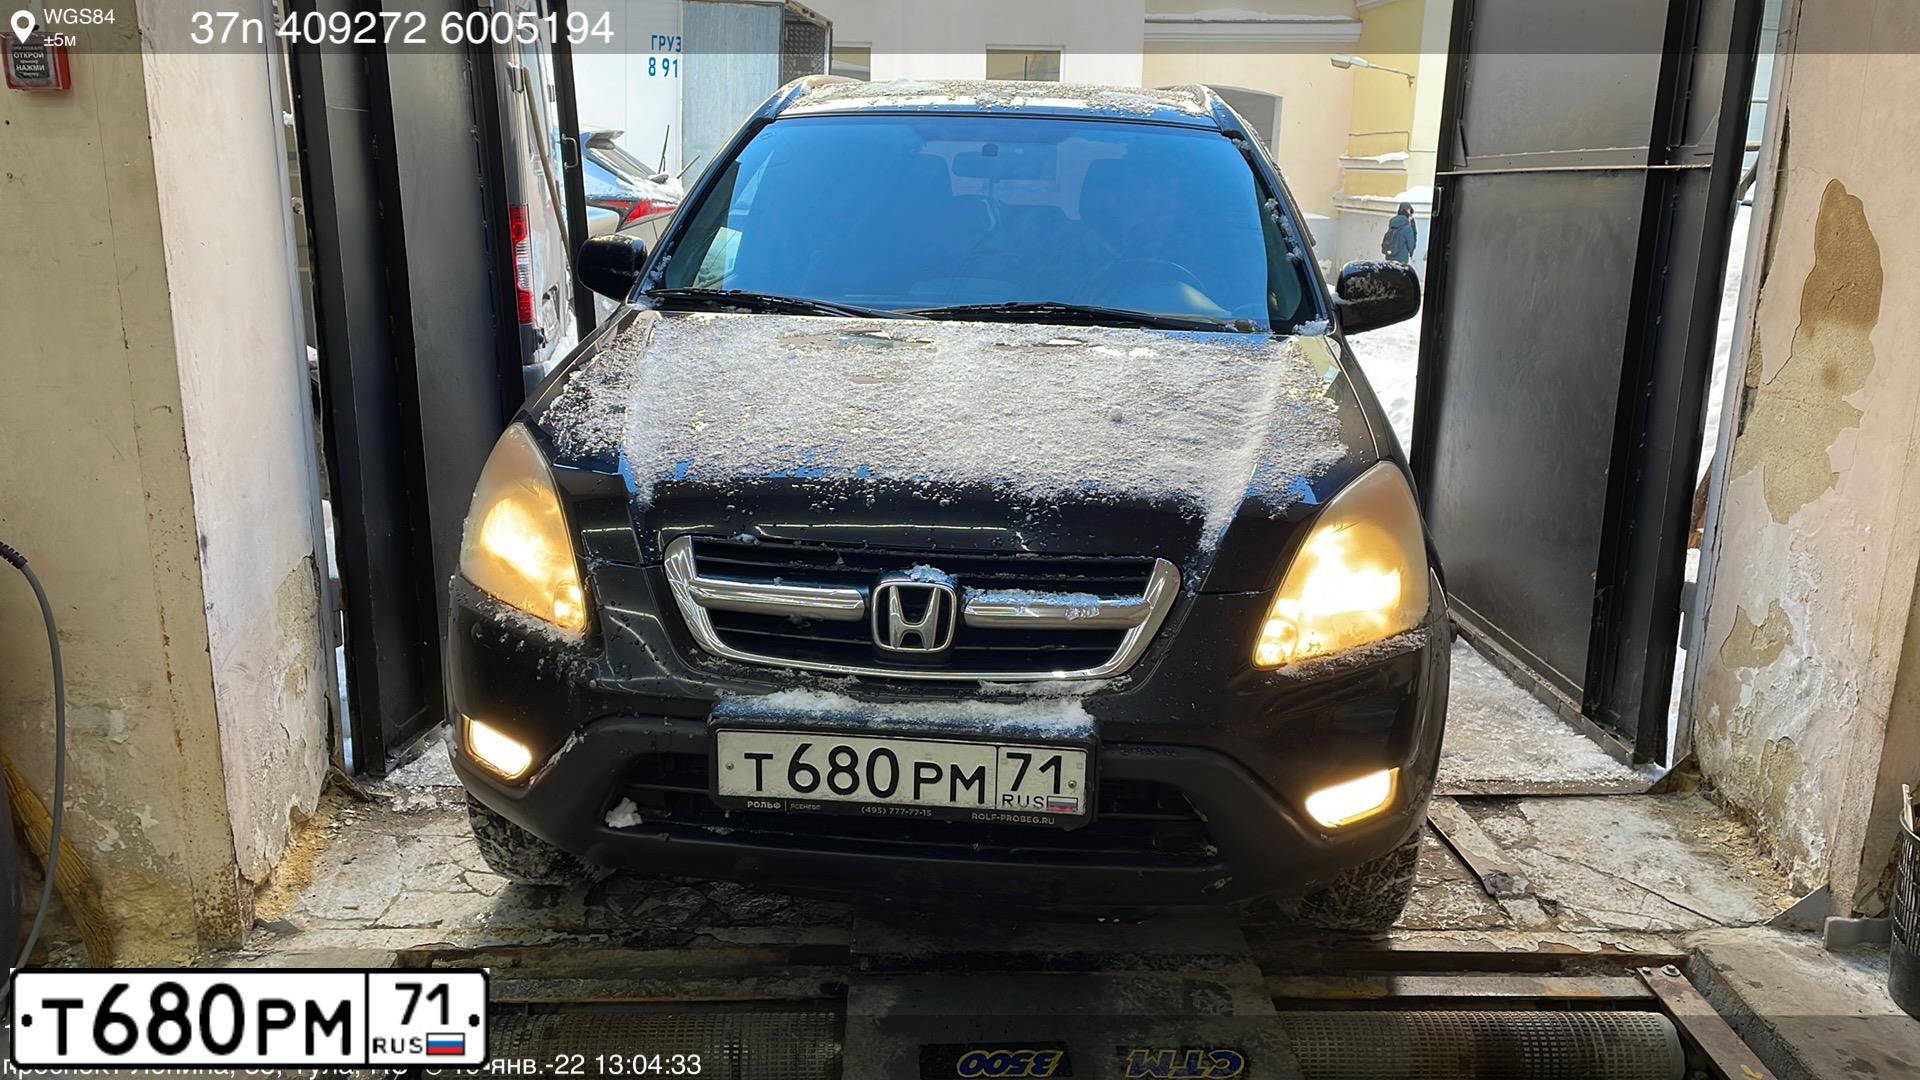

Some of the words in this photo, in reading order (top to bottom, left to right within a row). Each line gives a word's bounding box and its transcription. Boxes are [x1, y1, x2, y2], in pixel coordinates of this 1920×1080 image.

[648, 56, 657, 77] 8
[747, 800, 782, 810] РОЛЬФ
[1001, 793, 1045, 810] RUS
[860, 805, 886, 816] (495)
[888, 807, 932, 818] 777-77-15
[971, 812, 1056, 826] ROLF-PROBEG.RU
[956, 1049, 1064, 1077] 3500
